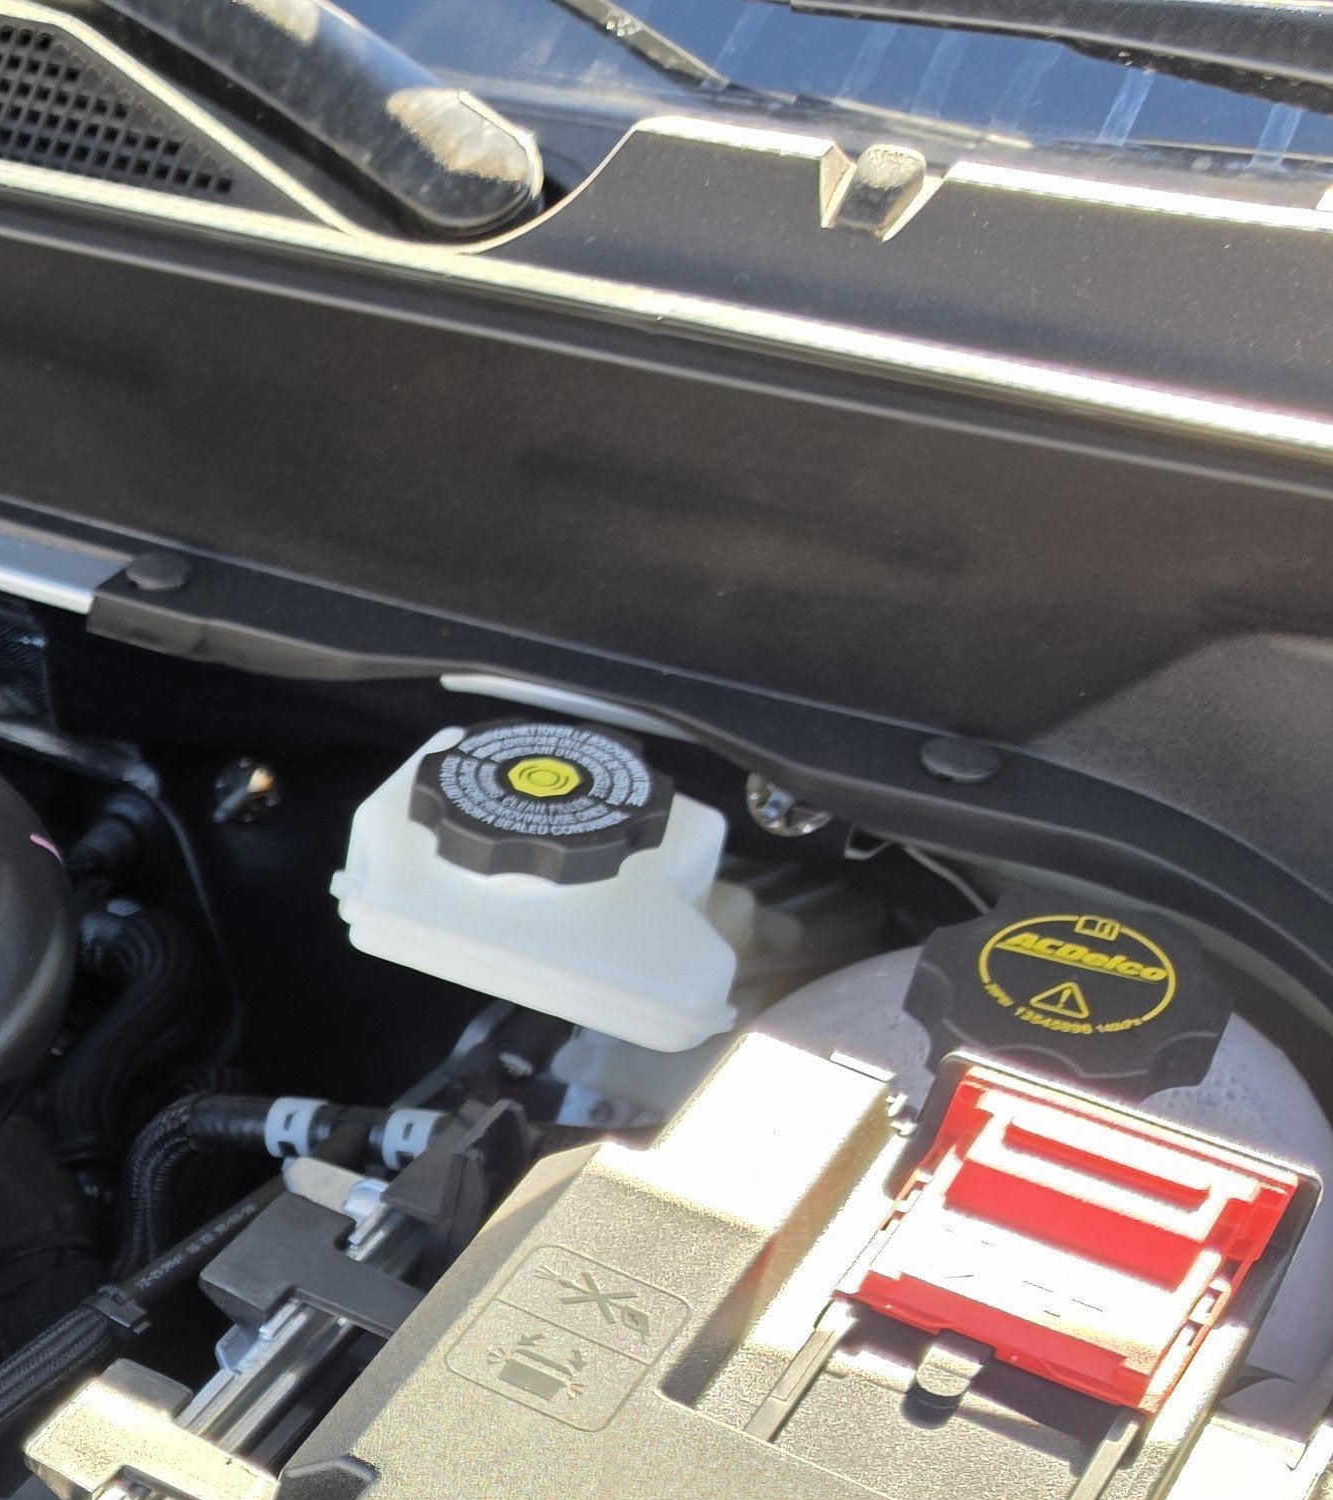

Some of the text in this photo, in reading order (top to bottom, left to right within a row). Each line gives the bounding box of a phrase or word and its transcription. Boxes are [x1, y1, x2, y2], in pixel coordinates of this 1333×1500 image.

[452, 797, 490, 820] FROM
[493, 815, 548, 834] SEALED
[480, 800, 547, 824] REMOVING
[548, 814, 576, 824] USE
[501, 795, 546, 815] CLEAN
[1004, 932, 1169, 982] ACDelco
